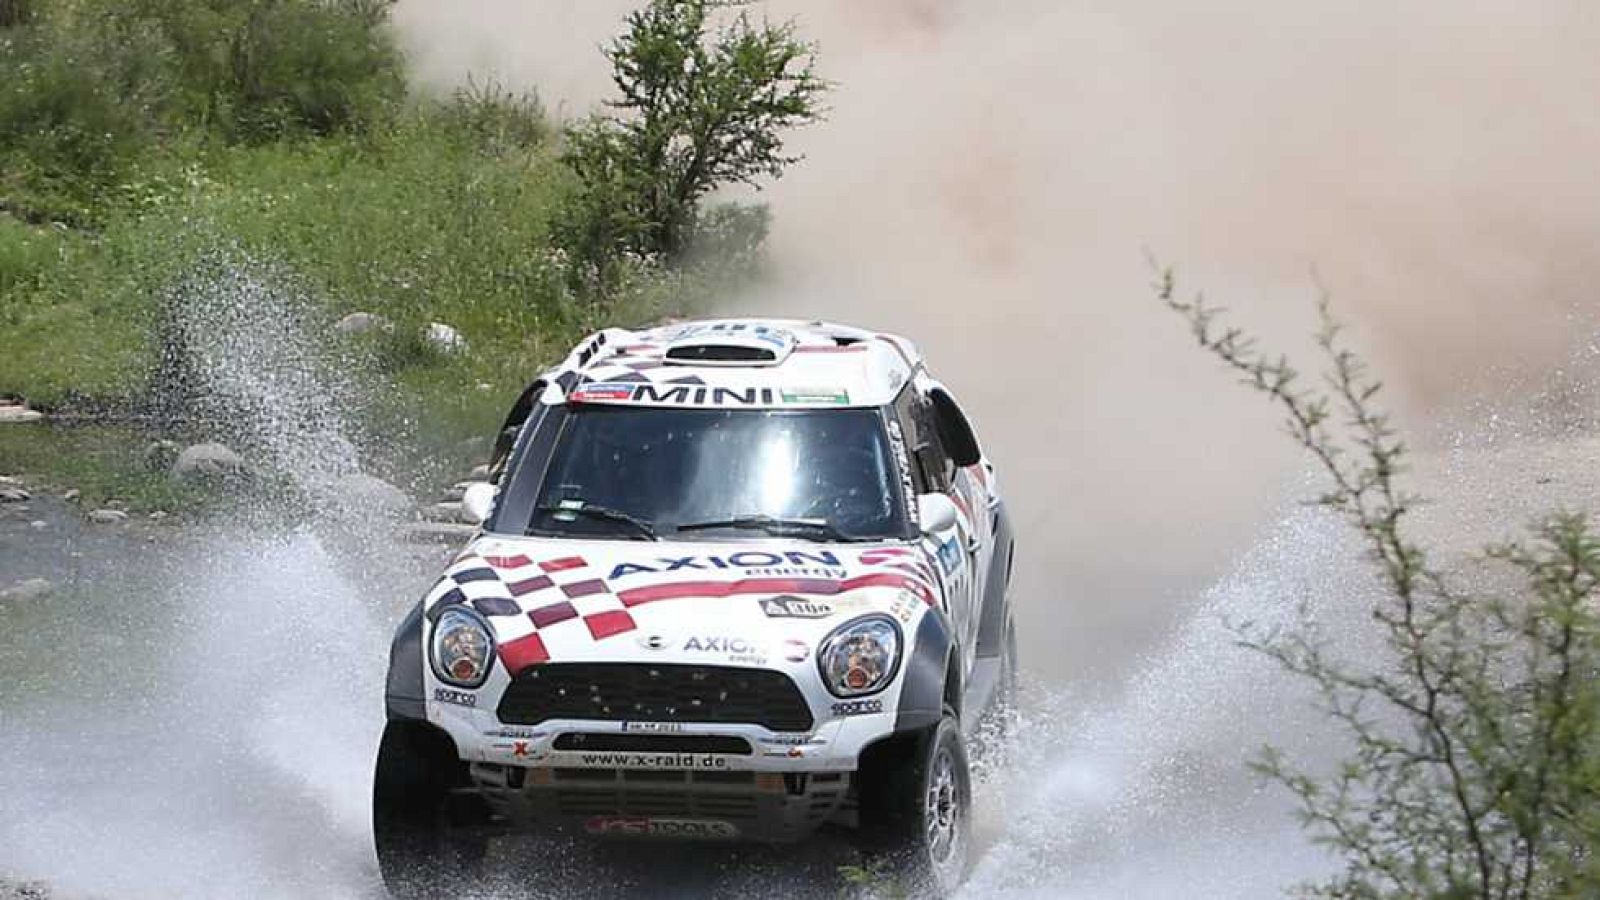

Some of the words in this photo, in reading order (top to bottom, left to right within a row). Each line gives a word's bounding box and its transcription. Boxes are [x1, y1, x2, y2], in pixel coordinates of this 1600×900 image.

[631, 385, 773, 404] MINI
[608, 551, 841, 580] AXION
[745, 567, 848, 579] energy
[434, 688, 477, 707] sparco
[831, 700, 883, 715] sparco
[582, 753, 726, 768] www.x-raid.de
